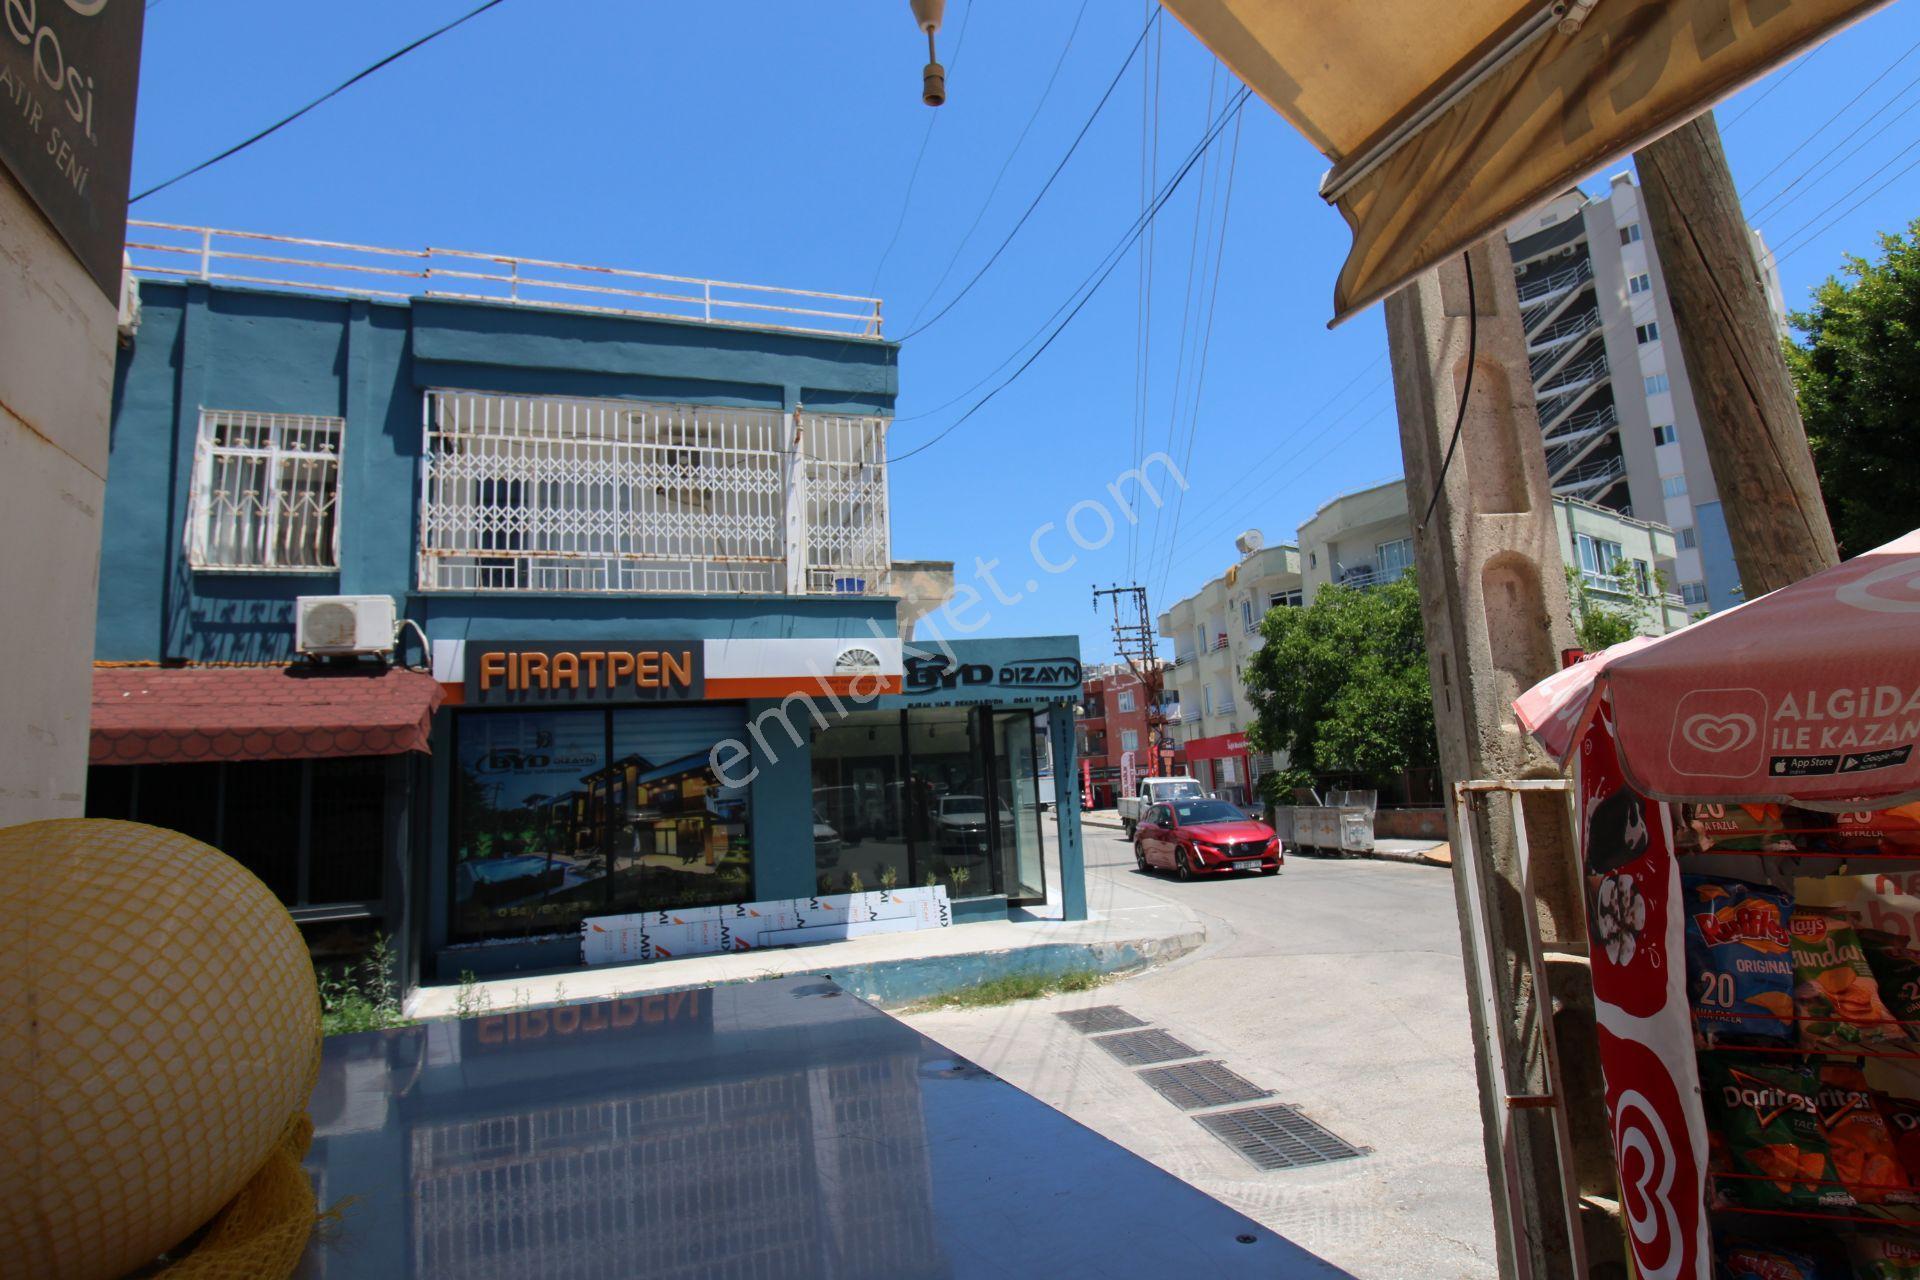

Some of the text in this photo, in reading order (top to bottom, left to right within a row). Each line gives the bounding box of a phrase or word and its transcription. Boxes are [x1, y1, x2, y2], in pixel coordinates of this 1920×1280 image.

[480, 650, 692, 690] FIRATPEN
[1791, 758, 1810, 768] App
[1811, 758, 1834, 767] Store
[1736, 959, 1794, 975] ORIGINAL
[1700, 971, 1736, 1009] 20
[1722, 1085, 1817, 1114] Doritos
